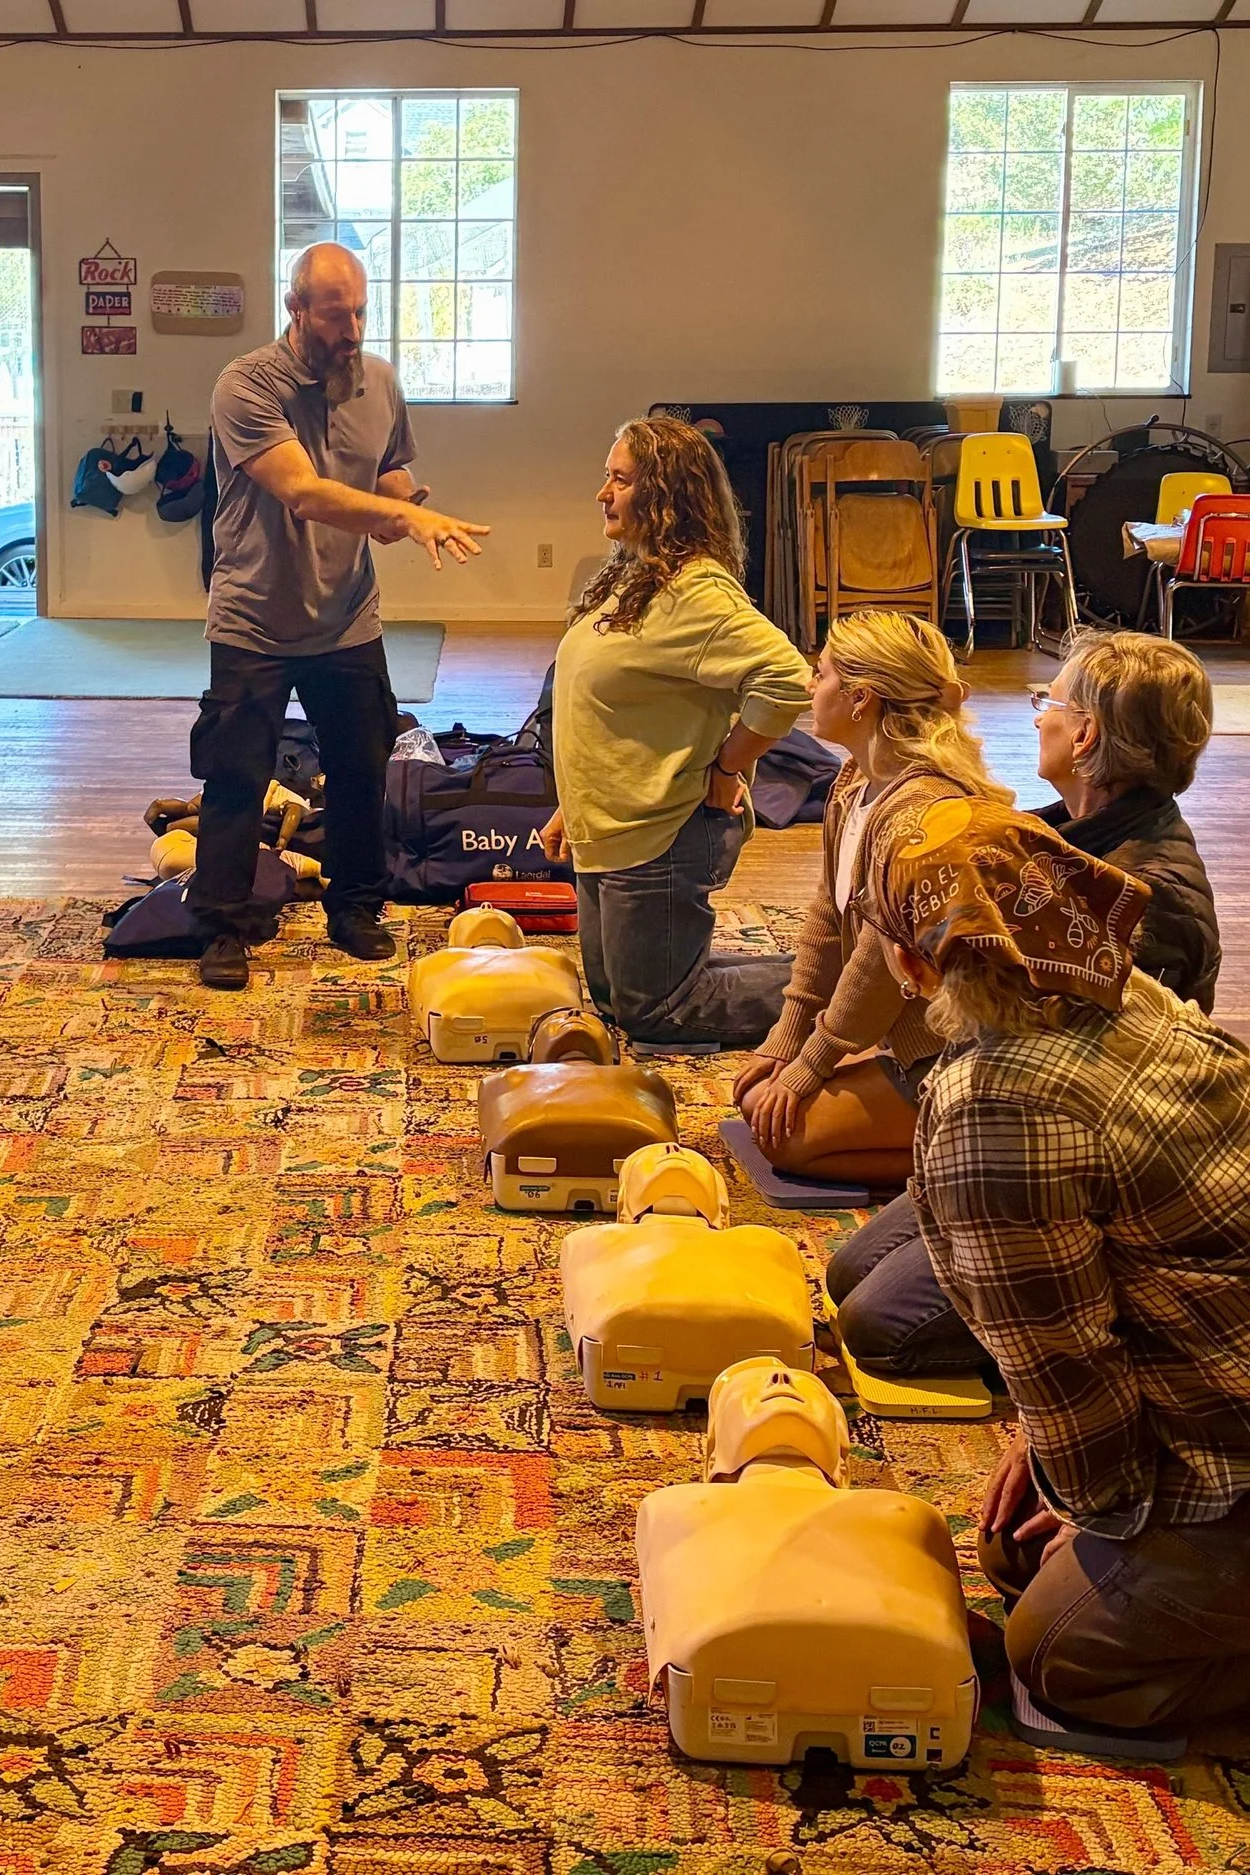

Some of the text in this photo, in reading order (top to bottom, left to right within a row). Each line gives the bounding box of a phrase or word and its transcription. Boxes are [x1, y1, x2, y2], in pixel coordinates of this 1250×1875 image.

[82, 260, 134, 283] Rock
[88, 293, 130, 313] PAPER
[462, 829, 519, 857] Baby
[937, 863, 960, 886] EL
